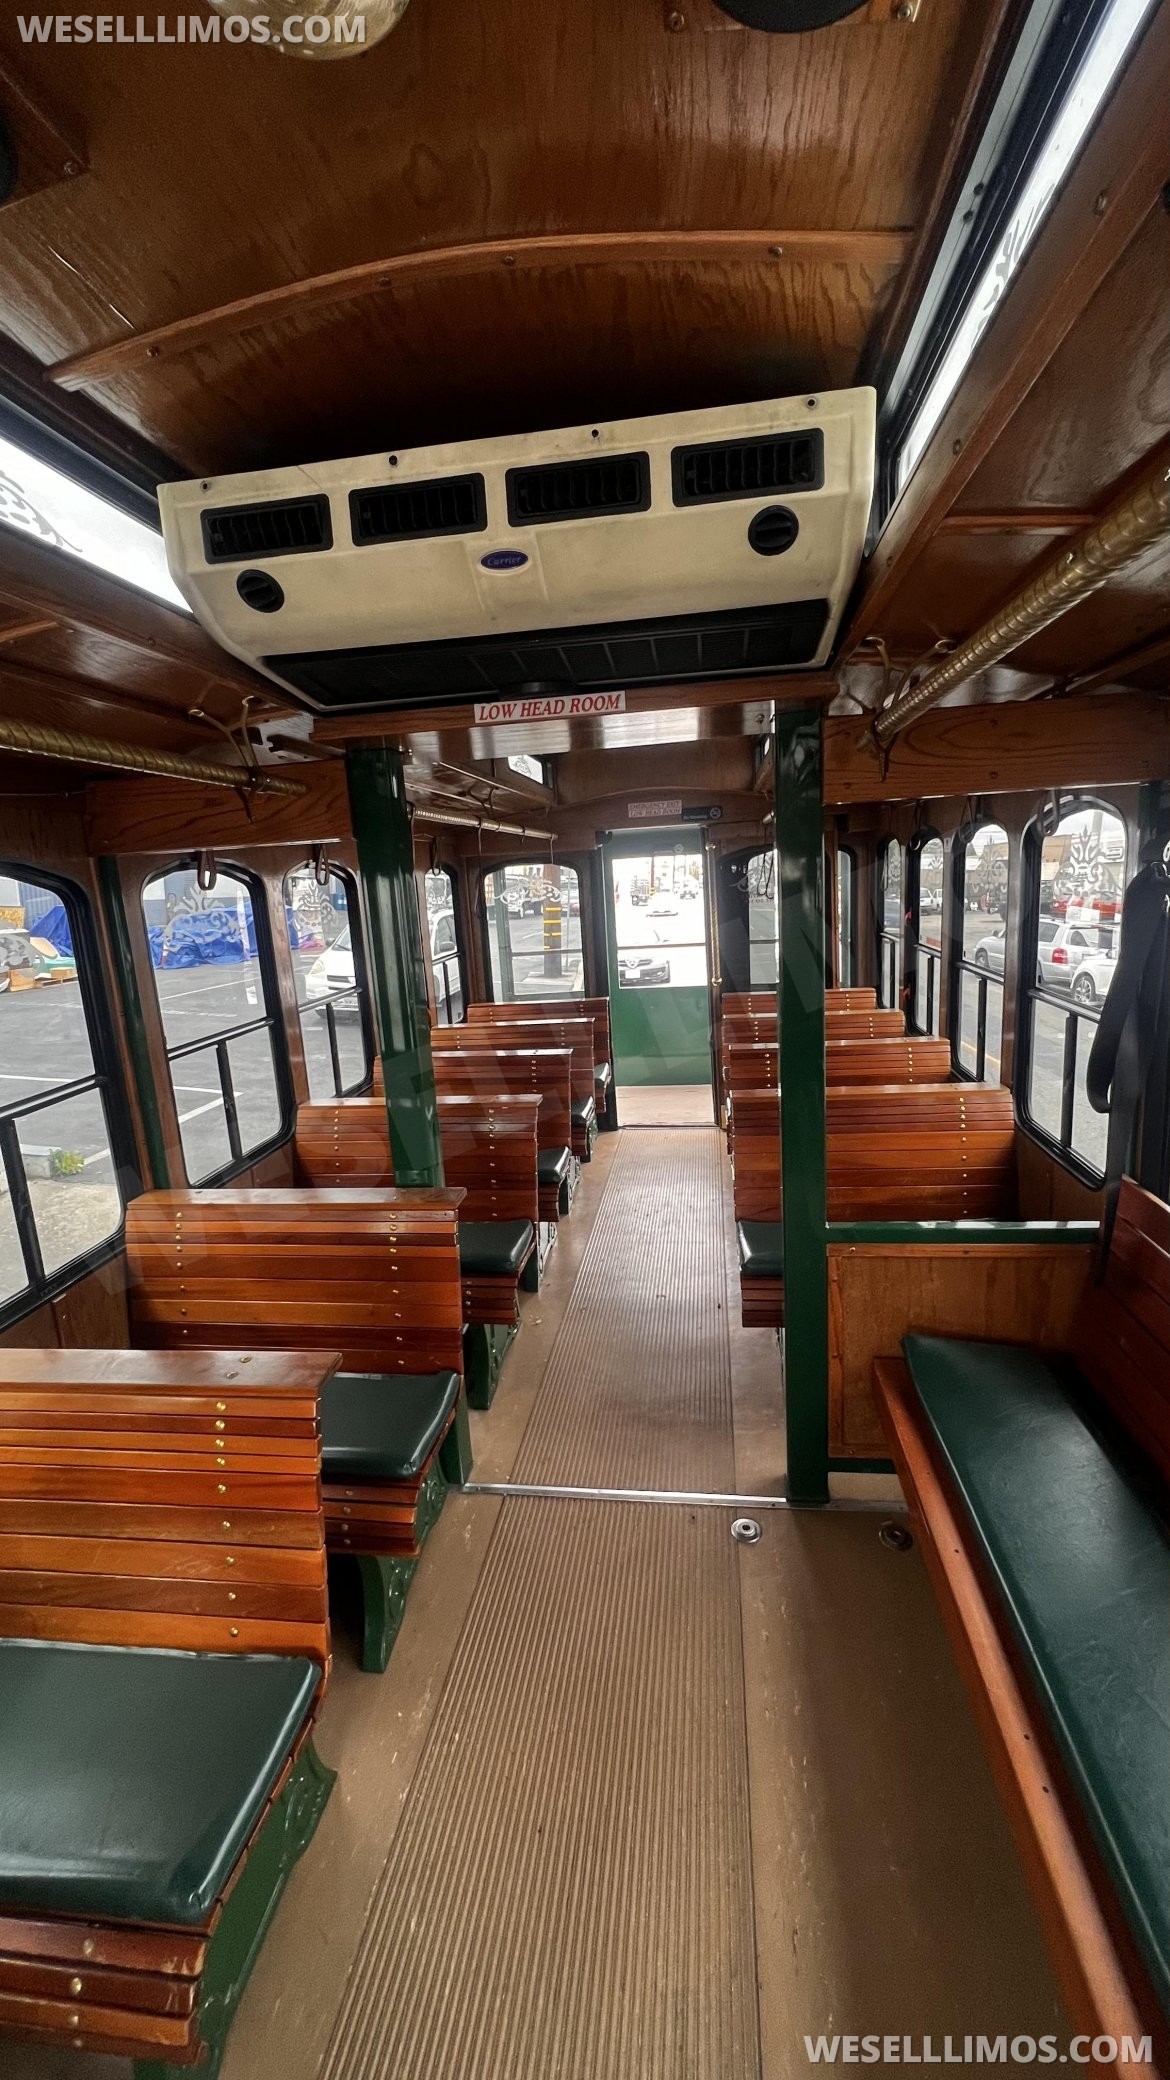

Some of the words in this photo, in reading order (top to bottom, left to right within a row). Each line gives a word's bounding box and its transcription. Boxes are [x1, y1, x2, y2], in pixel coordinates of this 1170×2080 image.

[487, 556, 522, 566] Carrier
[479, 703, 518, 721] LOW
[520, 699, 566, 718] HEAD
[569, 694, 622, 713] ROOM
